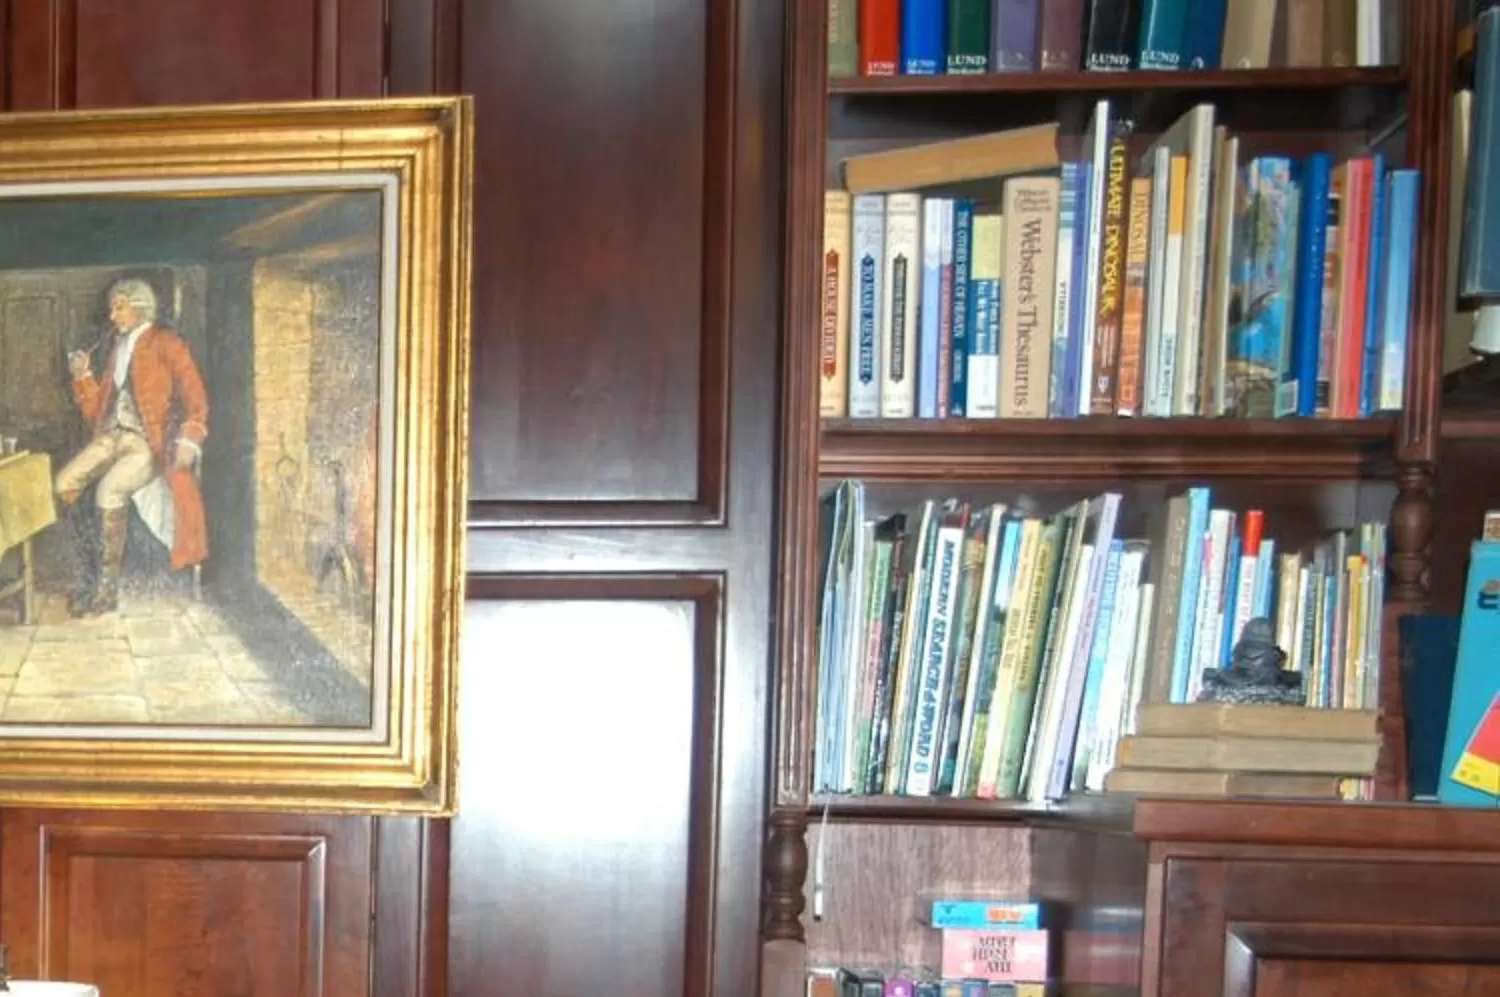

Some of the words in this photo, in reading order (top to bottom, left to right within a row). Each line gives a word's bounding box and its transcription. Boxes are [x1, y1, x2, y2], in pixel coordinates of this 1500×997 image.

[947, 54, 987, 65] LUND
[1090, 52, 1130, 65] LUND
[1141, 50, 1180, 64] LUND
[1108, 145, 1125, 217] ULTIMATE
[1018, 219, 1043, 303] Webster's
[1015, 307, 1038, 405] Thesaurus
[936, 540, 955, 616] MODERN
